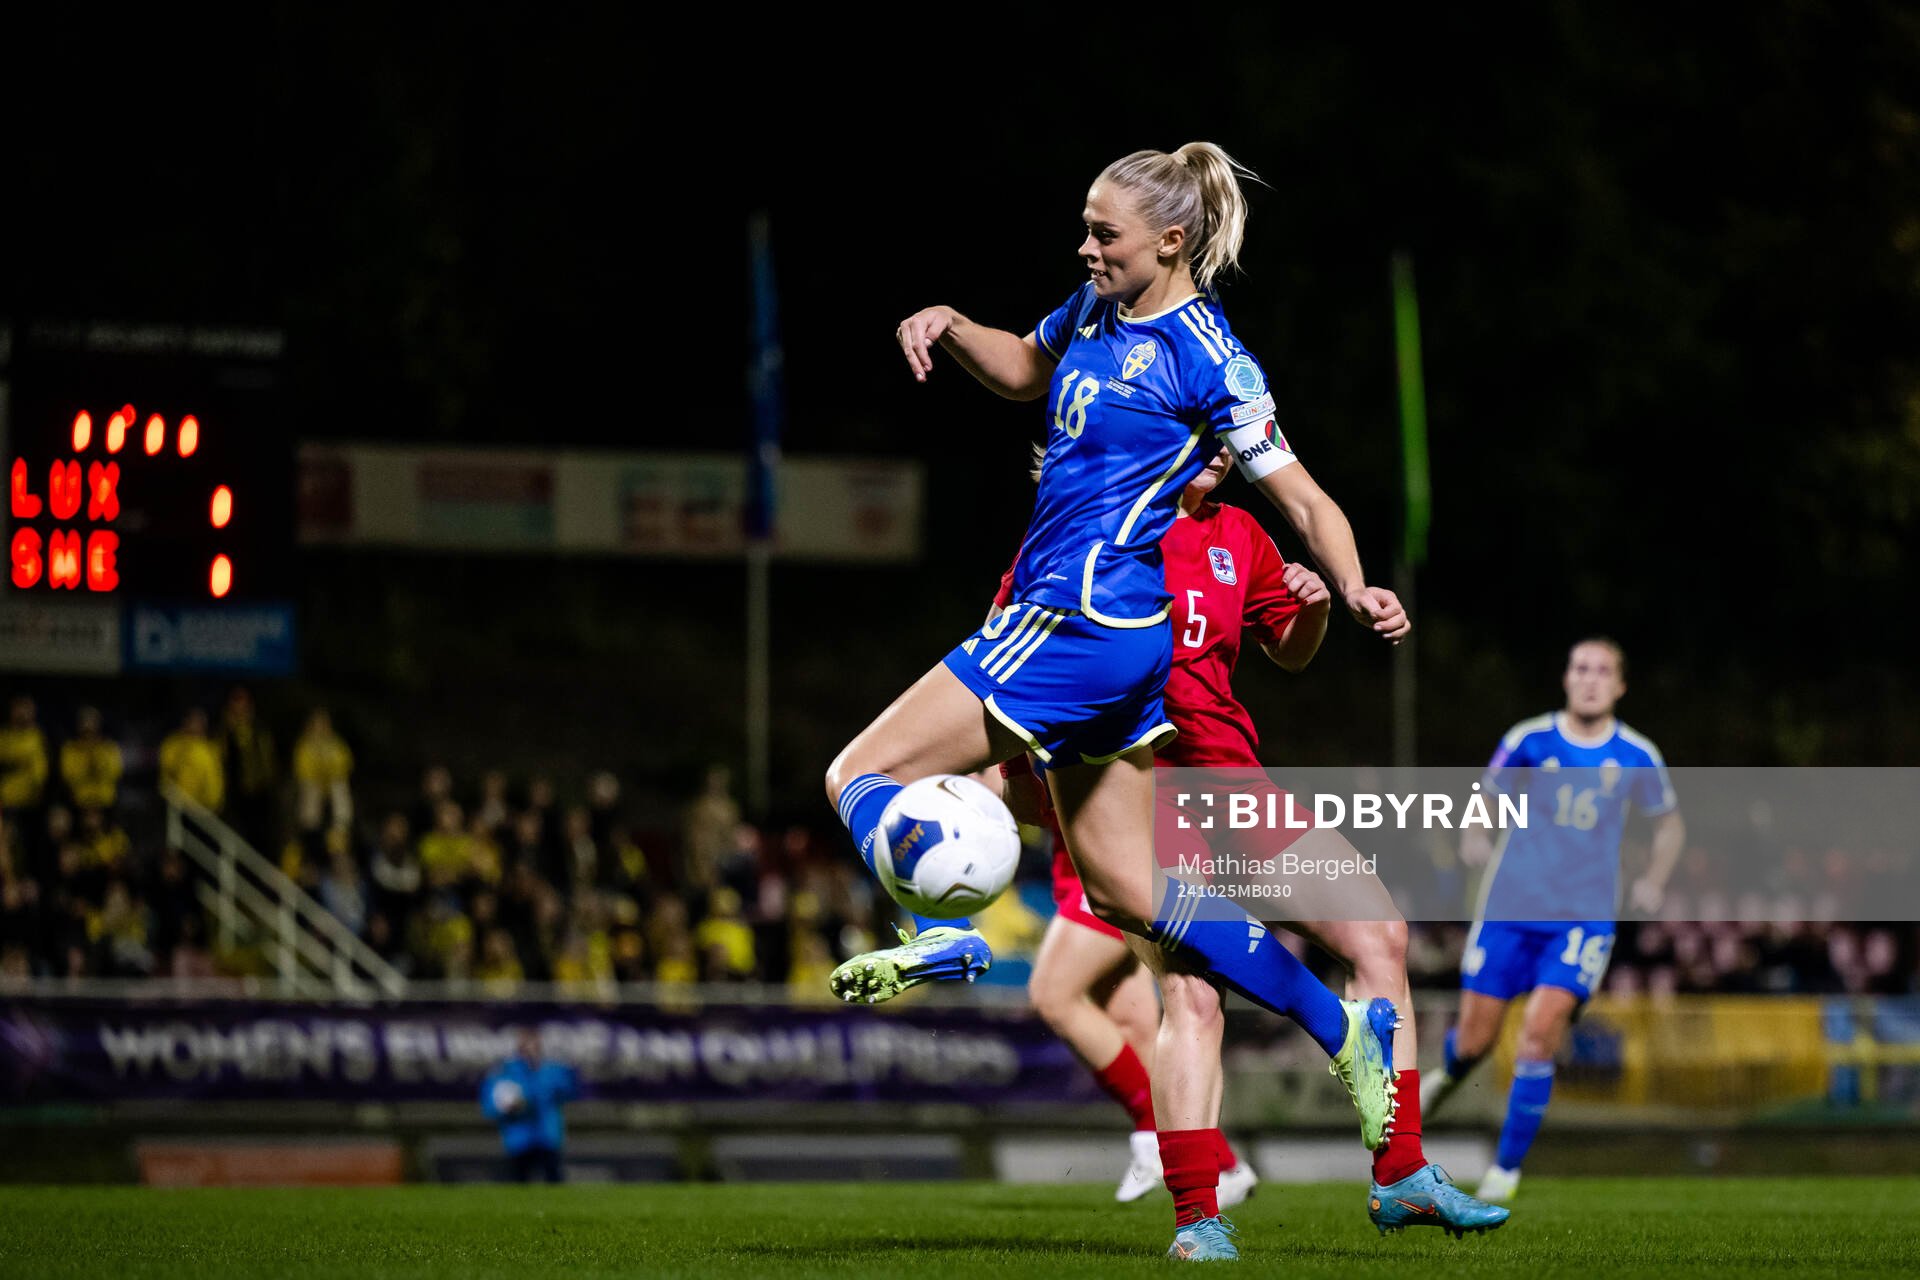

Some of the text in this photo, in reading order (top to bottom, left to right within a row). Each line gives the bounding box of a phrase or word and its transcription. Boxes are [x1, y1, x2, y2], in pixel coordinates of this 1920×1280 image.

[1055, 369, 1100, 440] 18
[11, 457, 120, 521] LUX
[11, 526, 120, 592] SWE
[1183, 589, 1207, 649] 5
[1554, 784, 1598, 831] 16
[1561, 926, 1613, 975] 16
